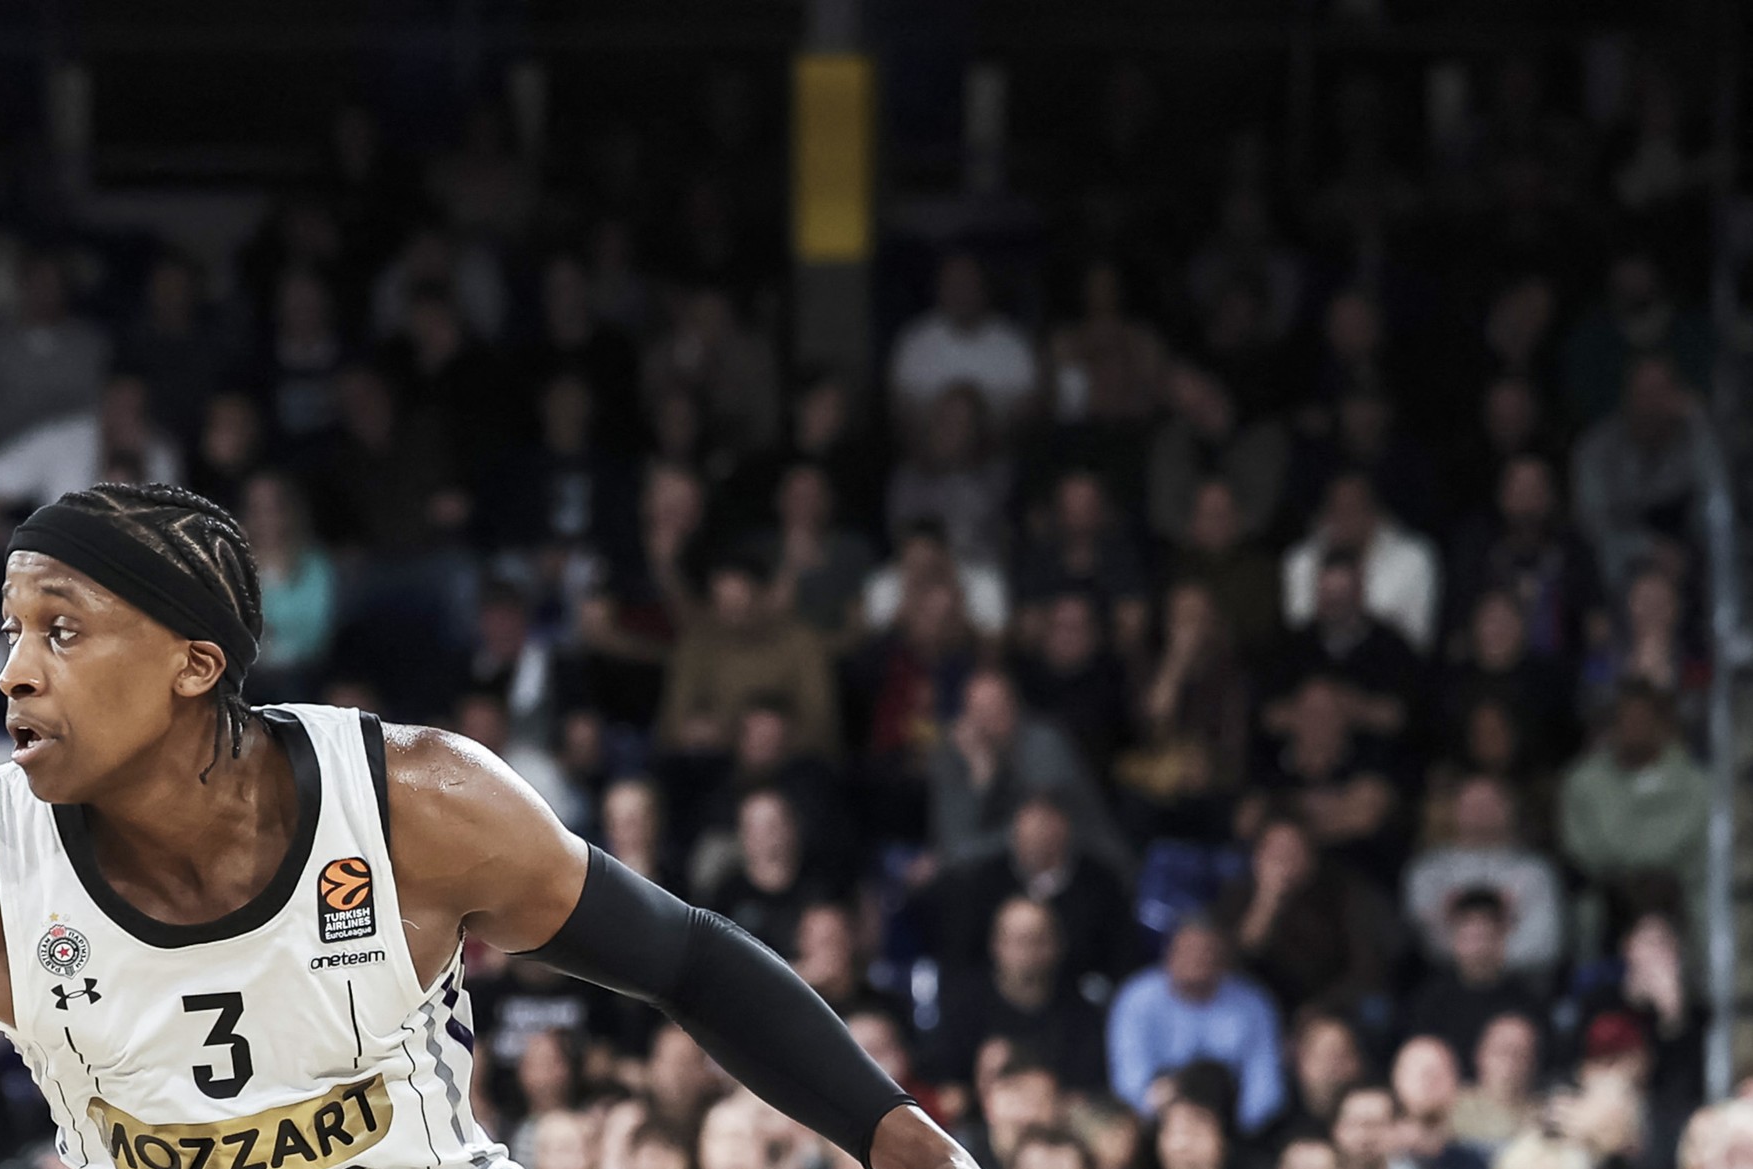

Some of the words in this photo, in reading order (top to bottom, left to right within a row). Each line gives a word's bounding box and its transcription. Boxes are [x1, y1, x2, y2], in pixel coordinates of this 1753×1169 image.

[324, 907, 371, 923] TURKISH
[325, 916, 371, 932] AIRLINES
[325, 926, 372, 940] EuroLeague
[310, 950, 385, 970] oneteam
[181, 991, 254, 1100] 3
